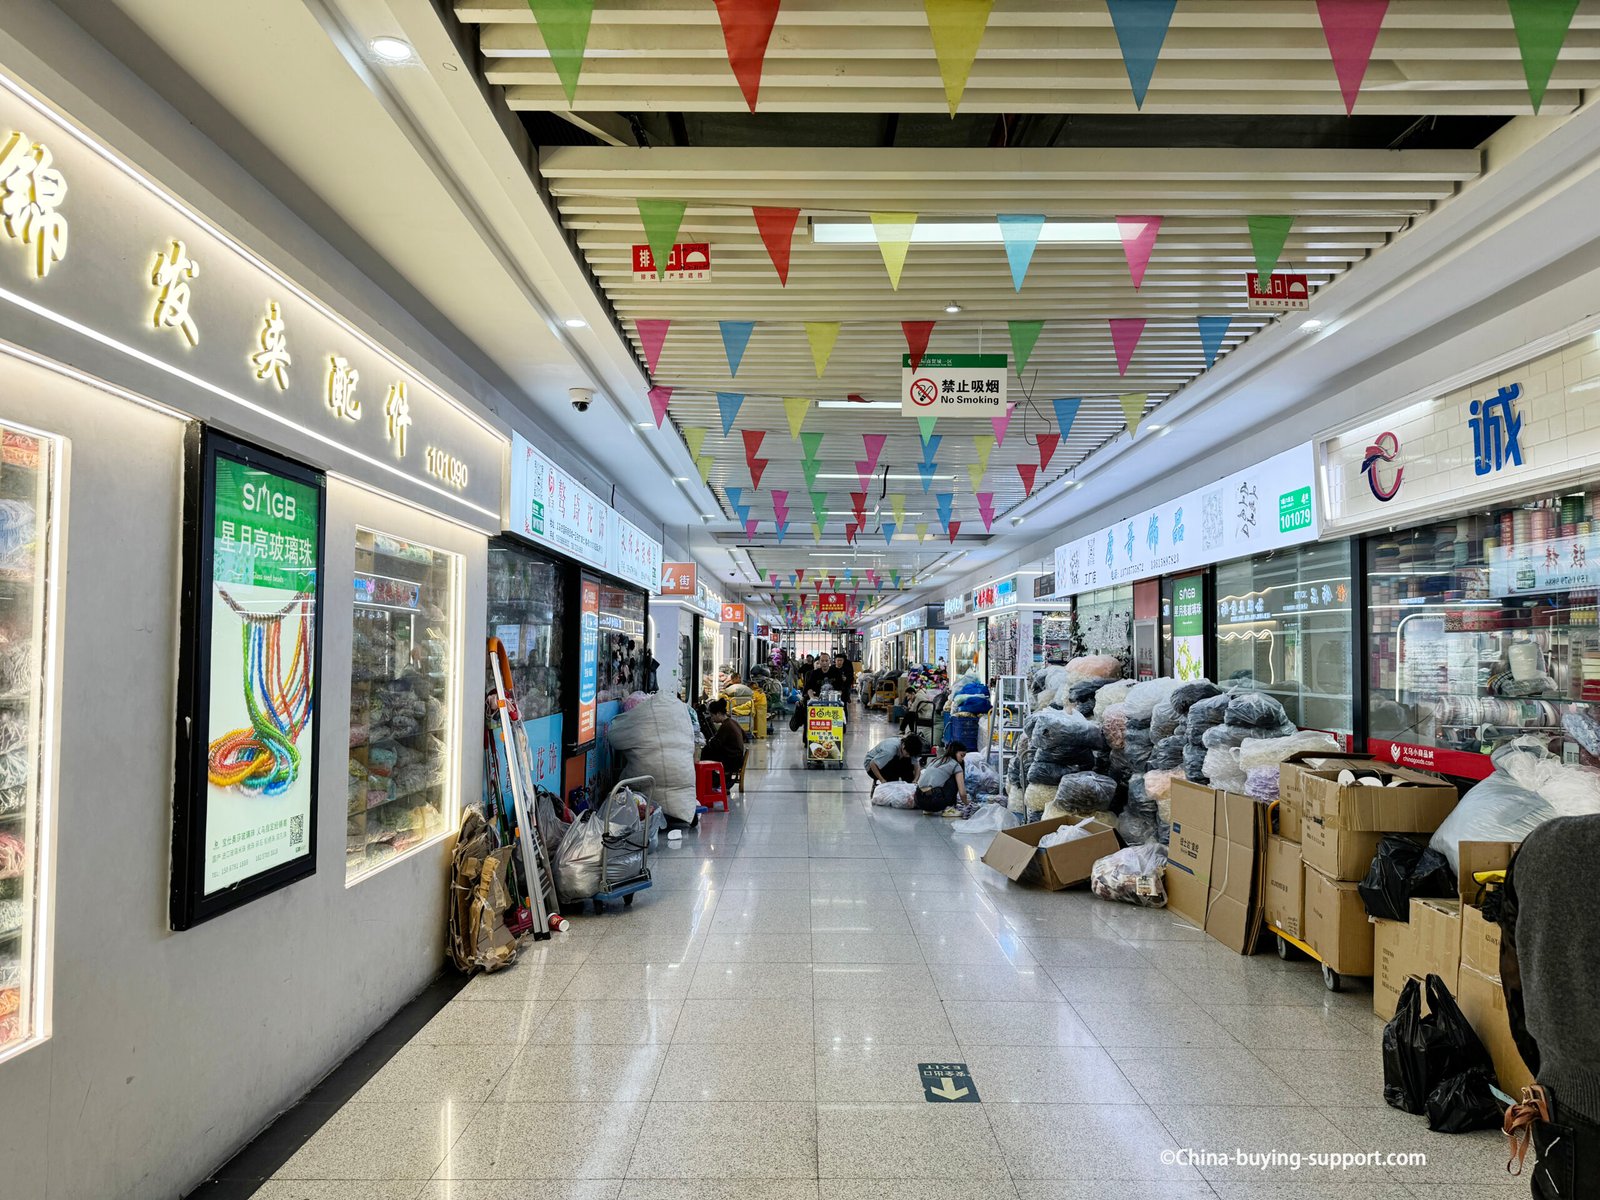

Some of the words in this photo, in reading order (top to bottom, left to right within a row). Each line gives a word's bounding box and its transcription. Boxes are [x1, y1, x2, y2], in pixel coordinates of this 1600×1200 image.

[639, 249, 676, 268] 排口
[941, 378, 1000, 394] 禁止吸烟
[940, 395, 955, 405] No
[956, 395, 1000, 406] Smoking
[1468, 382, 1524, 476] 诚
[424, 446, 470, 488] 101090
[1280, 508, 1311, 530] 101079
[219, 520, 313, 567] 星月亮玻璃珠
[661, 567, 676, 590] 4
[724, 606, 734, 620] 3
[1402, 746, 1435, 760] 义乌小商品城
[1402, 756, 1435, 767] chinagoods.com
